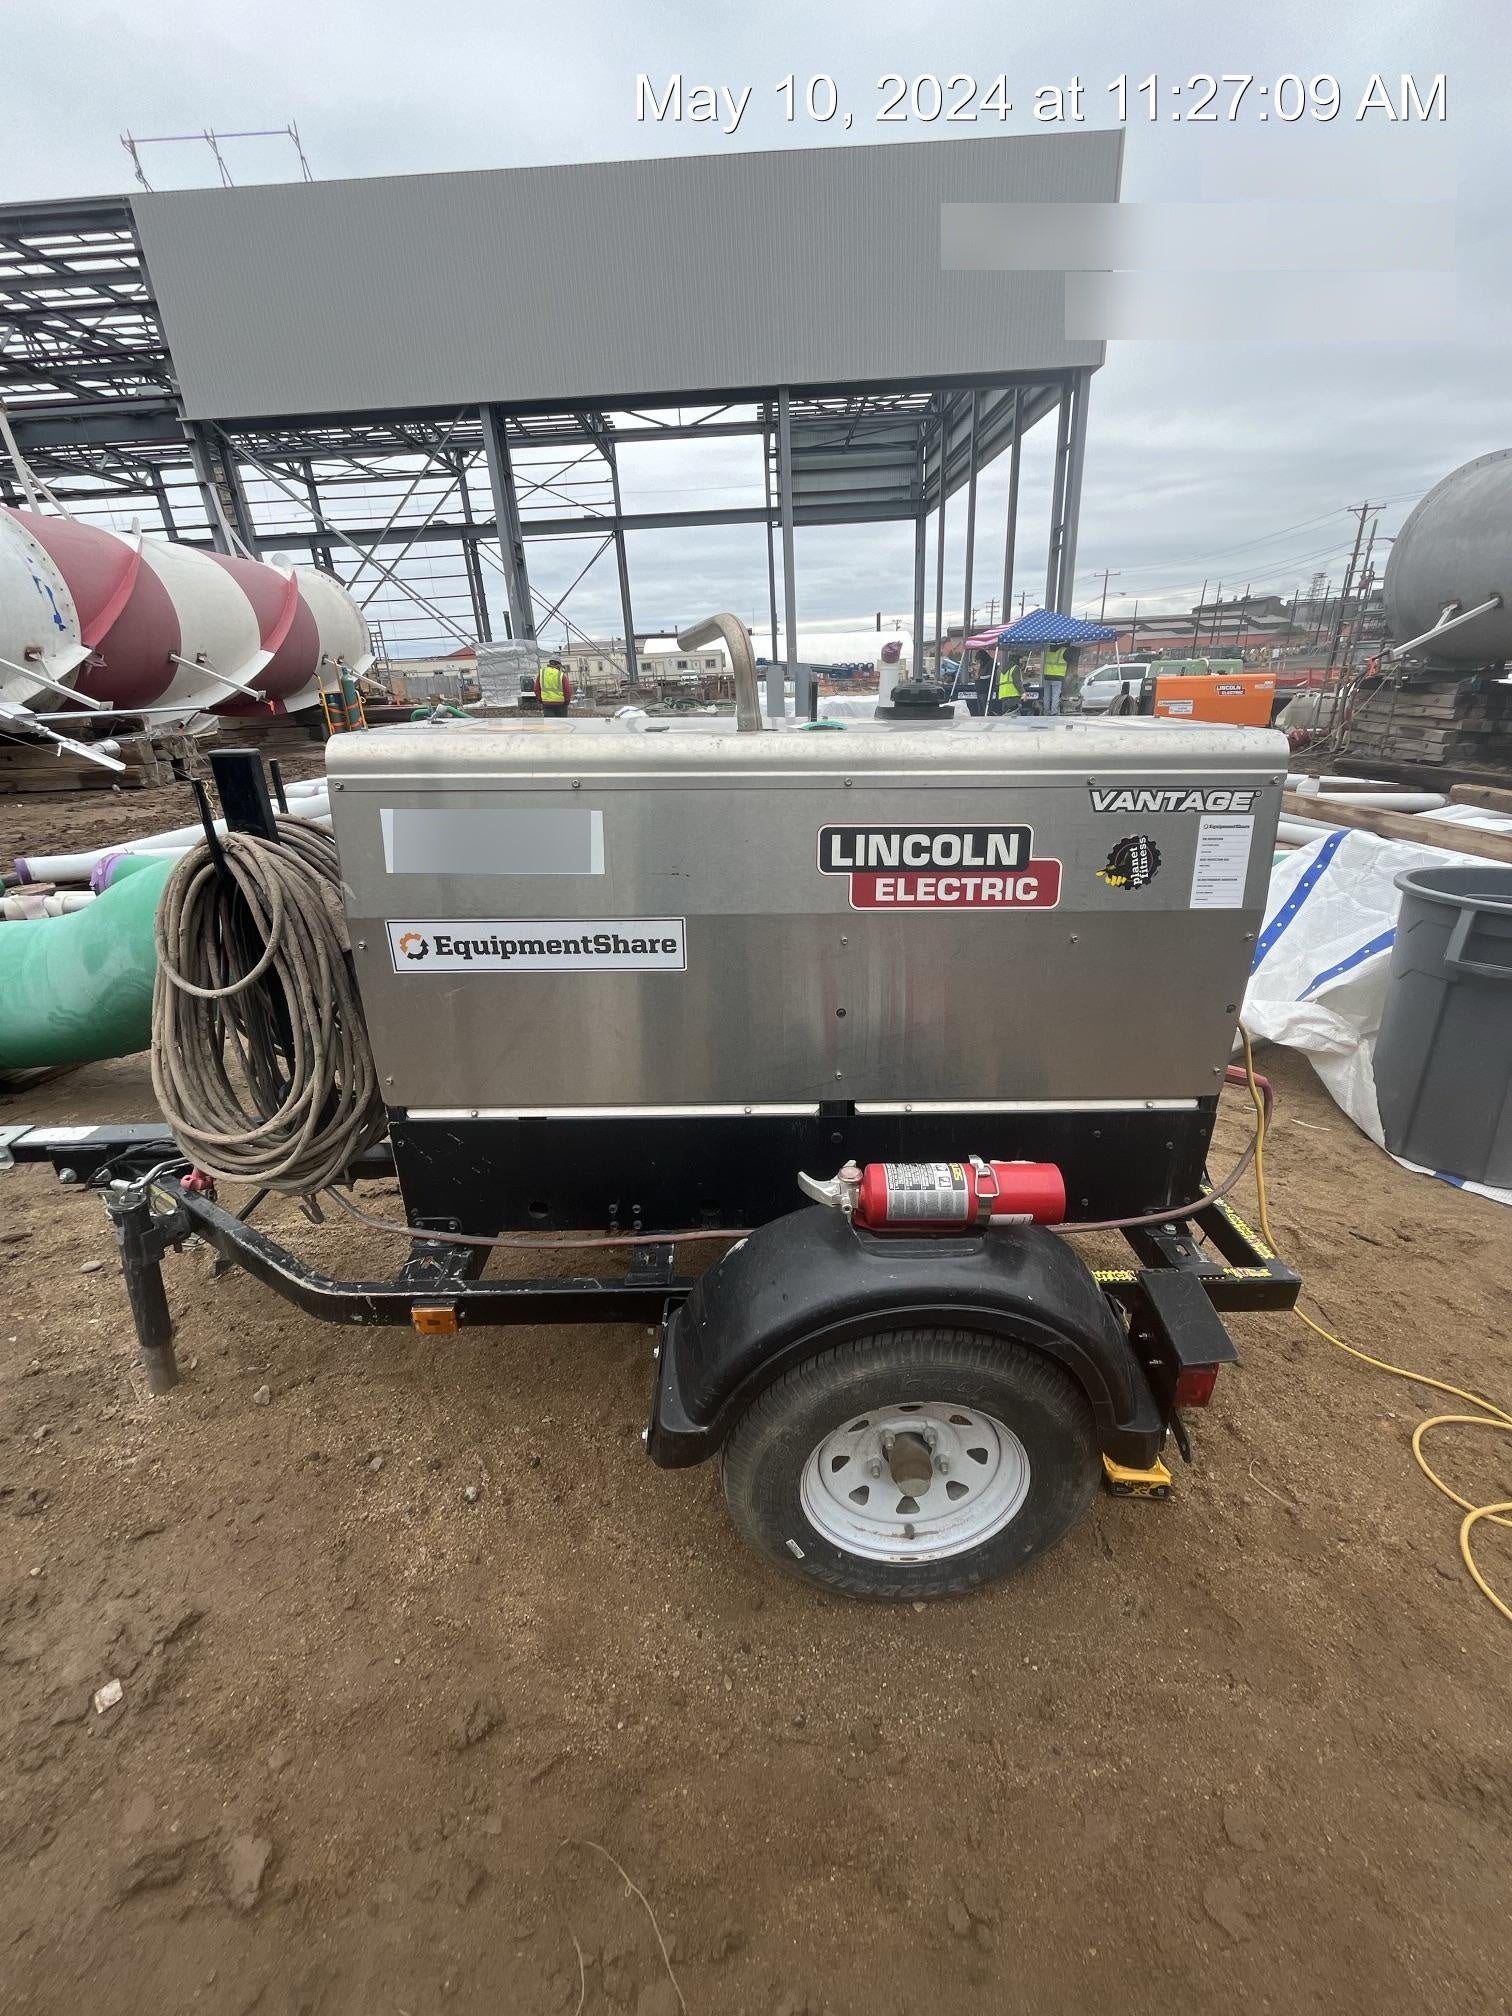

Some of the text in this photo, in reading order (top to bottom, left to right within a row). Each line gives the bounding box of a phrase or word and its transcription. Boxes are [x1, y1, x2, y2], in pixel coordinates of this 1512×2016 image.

[830, 833, 1020, 867] LINCOLN
[1130, 846, 1143, 886] planet
[1139, 837, 1149, 878] fitness
[874, 876, 1040, 902] ELECTRIC
[433, 933, 677, 960] EquipmentShare
